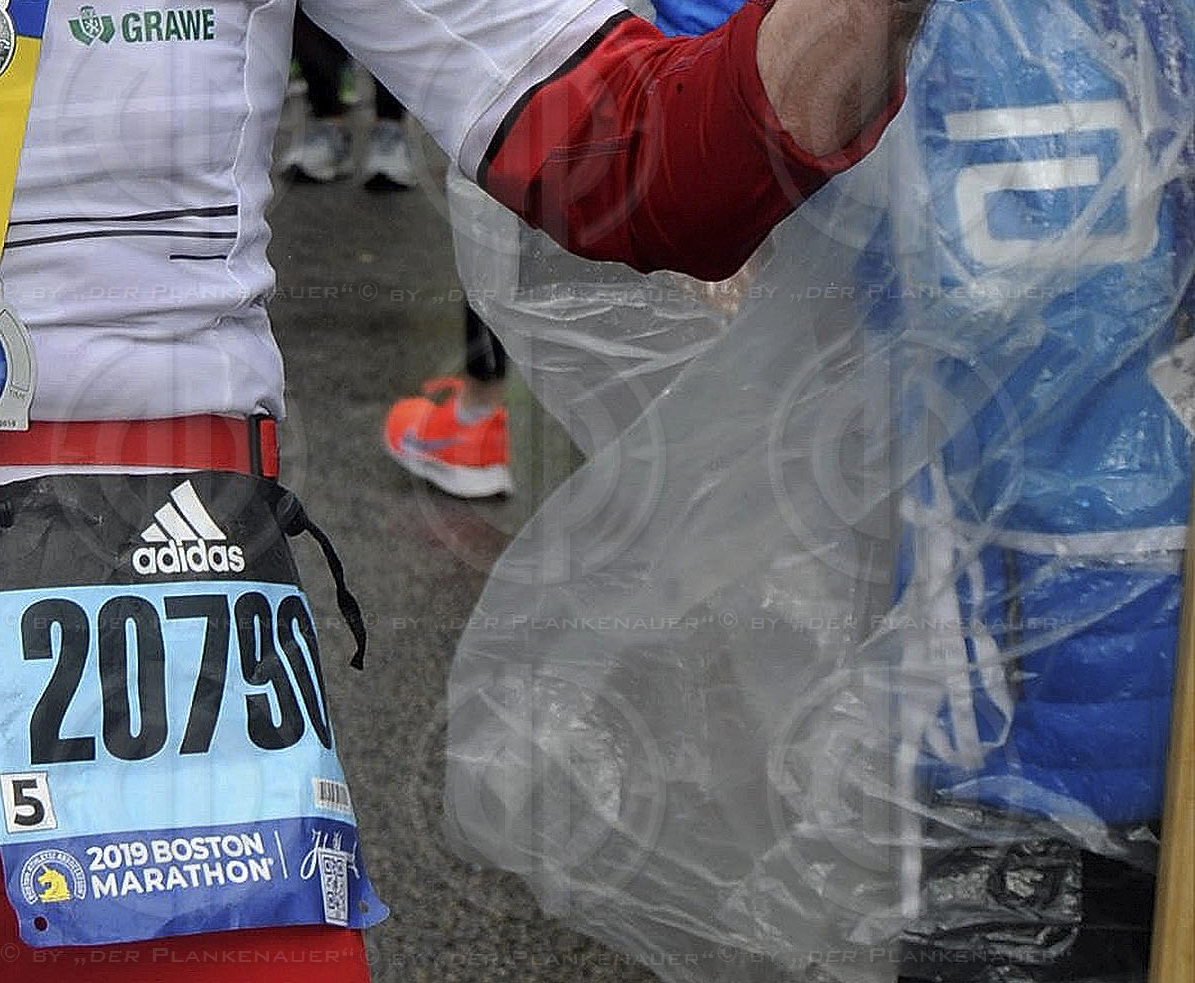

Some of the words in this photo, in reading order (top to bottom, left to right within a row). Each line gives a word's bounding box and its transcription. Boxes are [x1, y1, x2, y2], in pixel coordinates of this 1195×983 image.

[121, 8, 215, 43] GRAWE
[132, 539, 246, 575] adidas
[20, 590, 332, 765] 20790
[11, 779, 46, 827] 5
[86, 841, 149, 871] 2019
[151, 831, 265, 865] BOSTON
